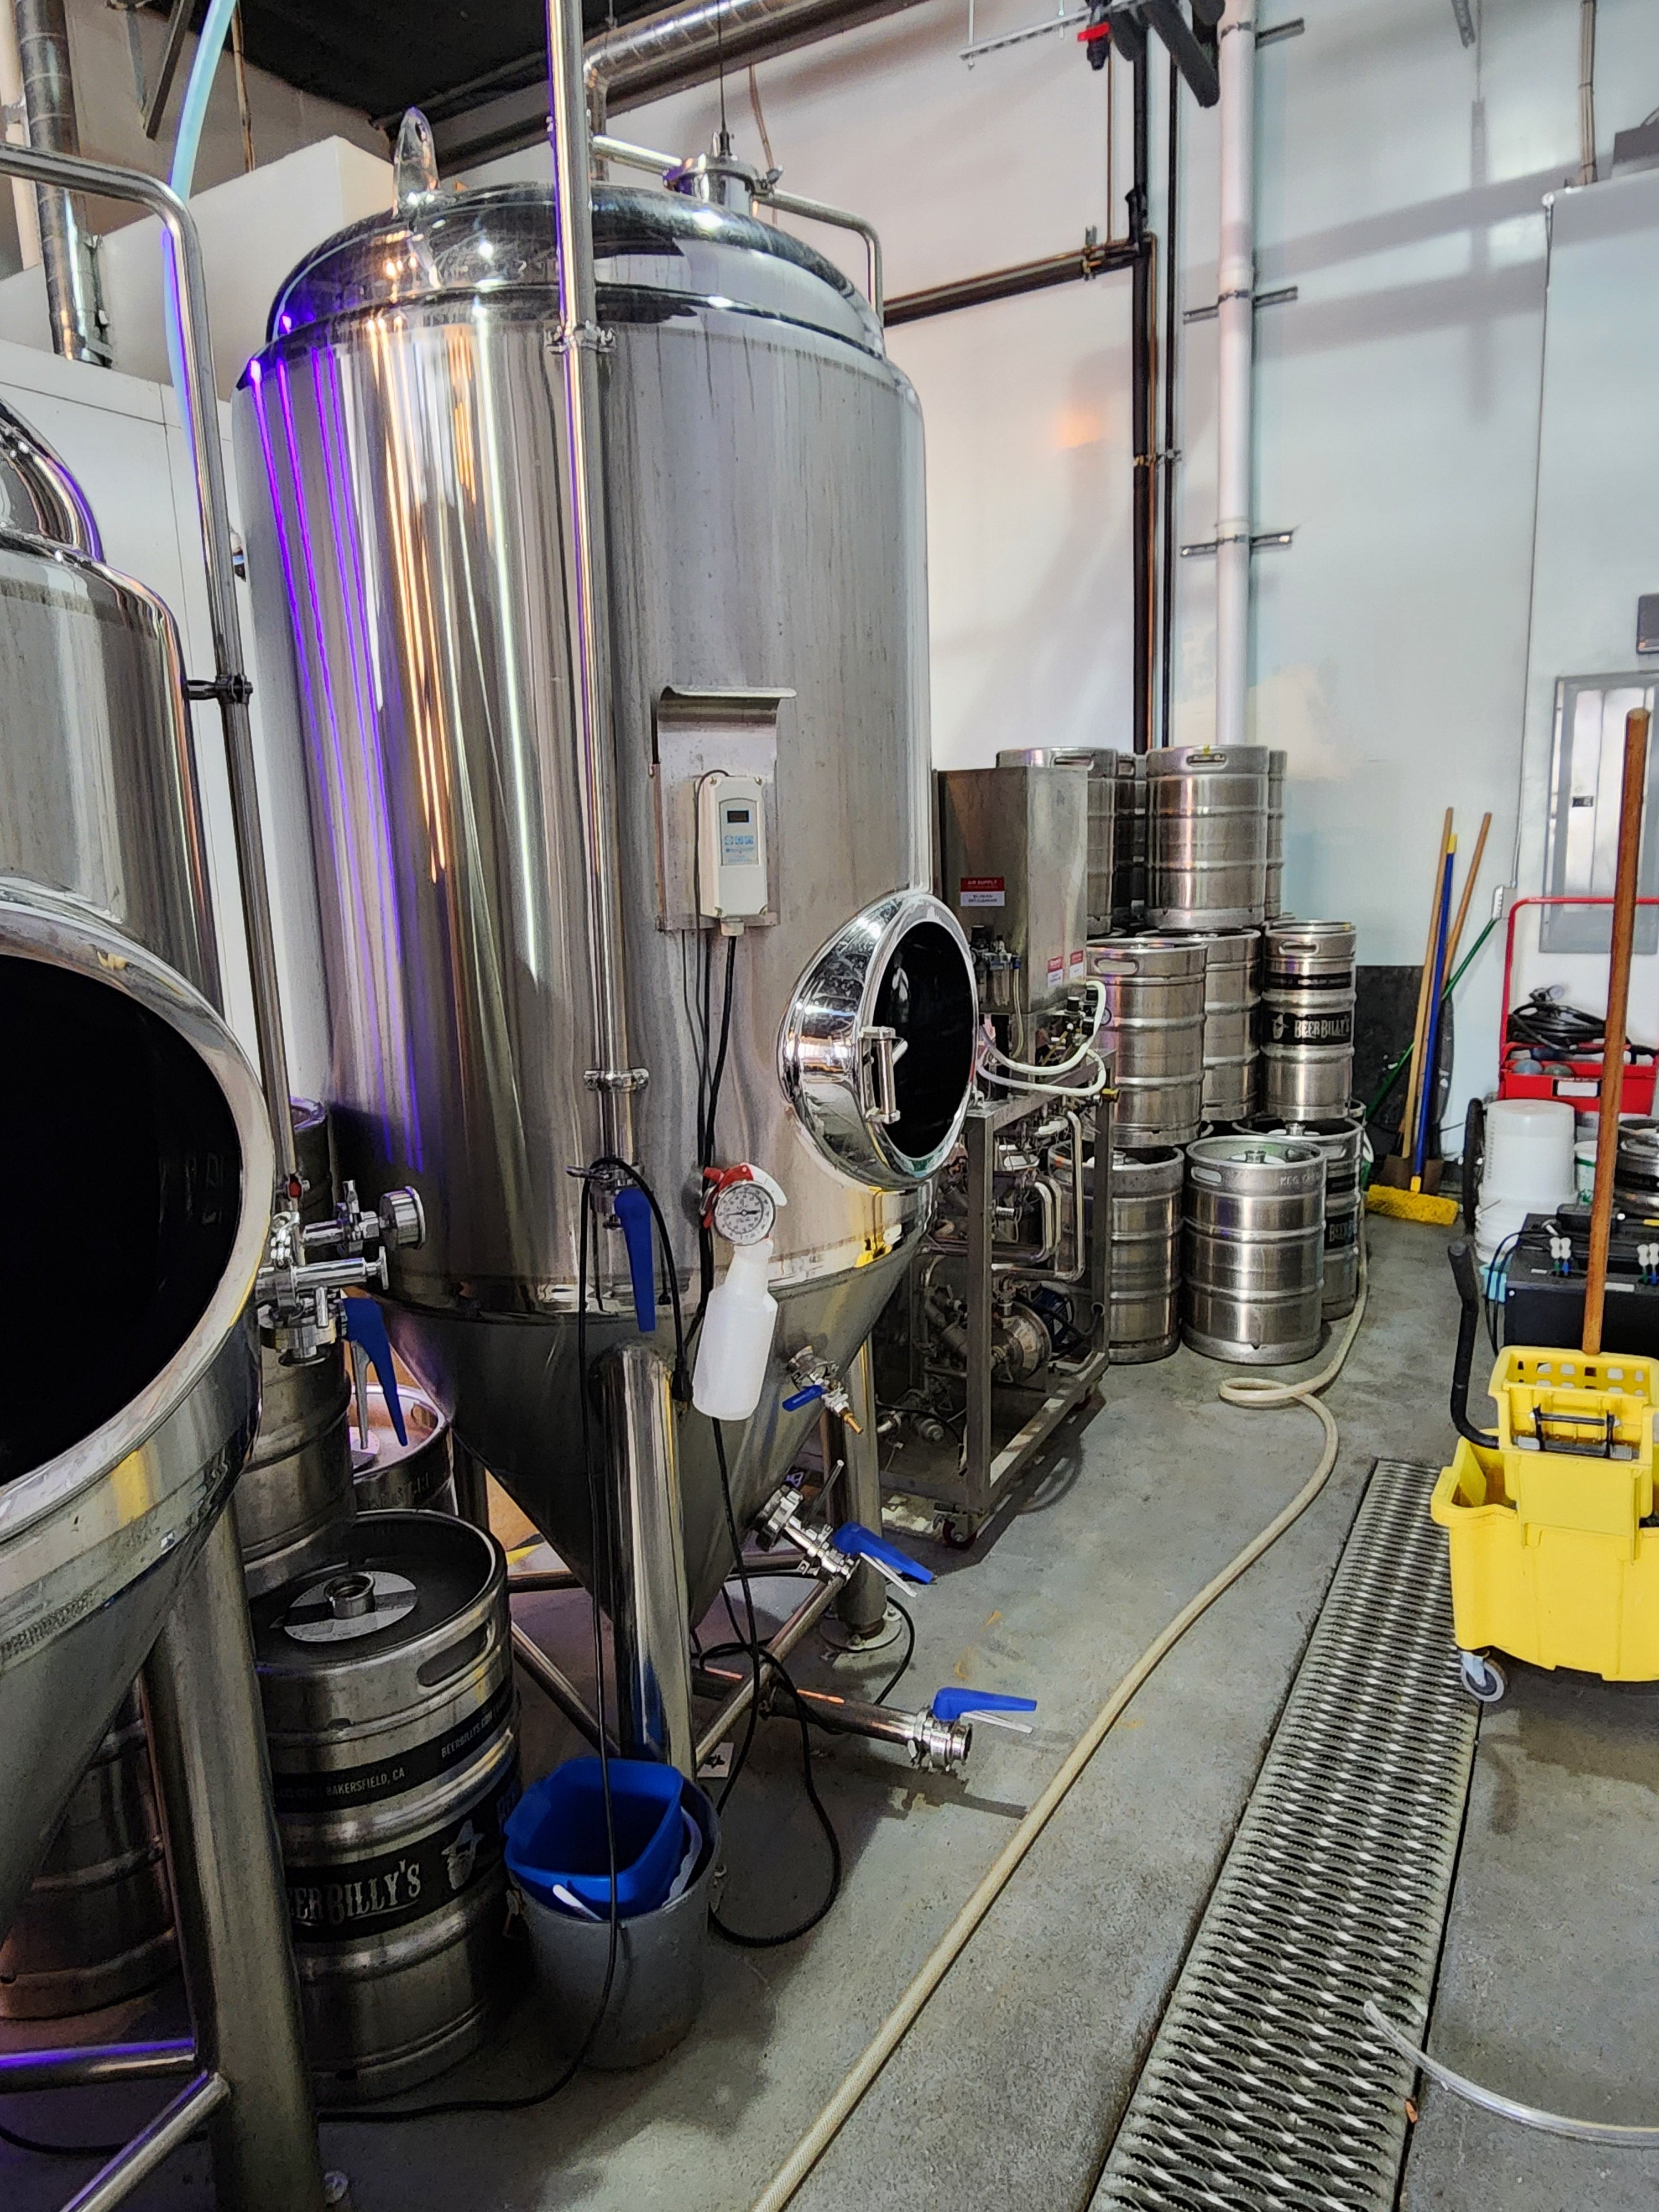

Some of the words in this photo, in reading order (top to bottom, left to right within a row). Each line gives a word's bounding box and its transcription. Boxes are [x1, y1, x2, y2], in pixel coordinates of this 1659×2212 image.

[326, 1772, 391, 1797] BAKERSFIELD,
[392, 1765, 405, 1781] CA
[288, 1859, 421, 1926] ERBILLY'S
